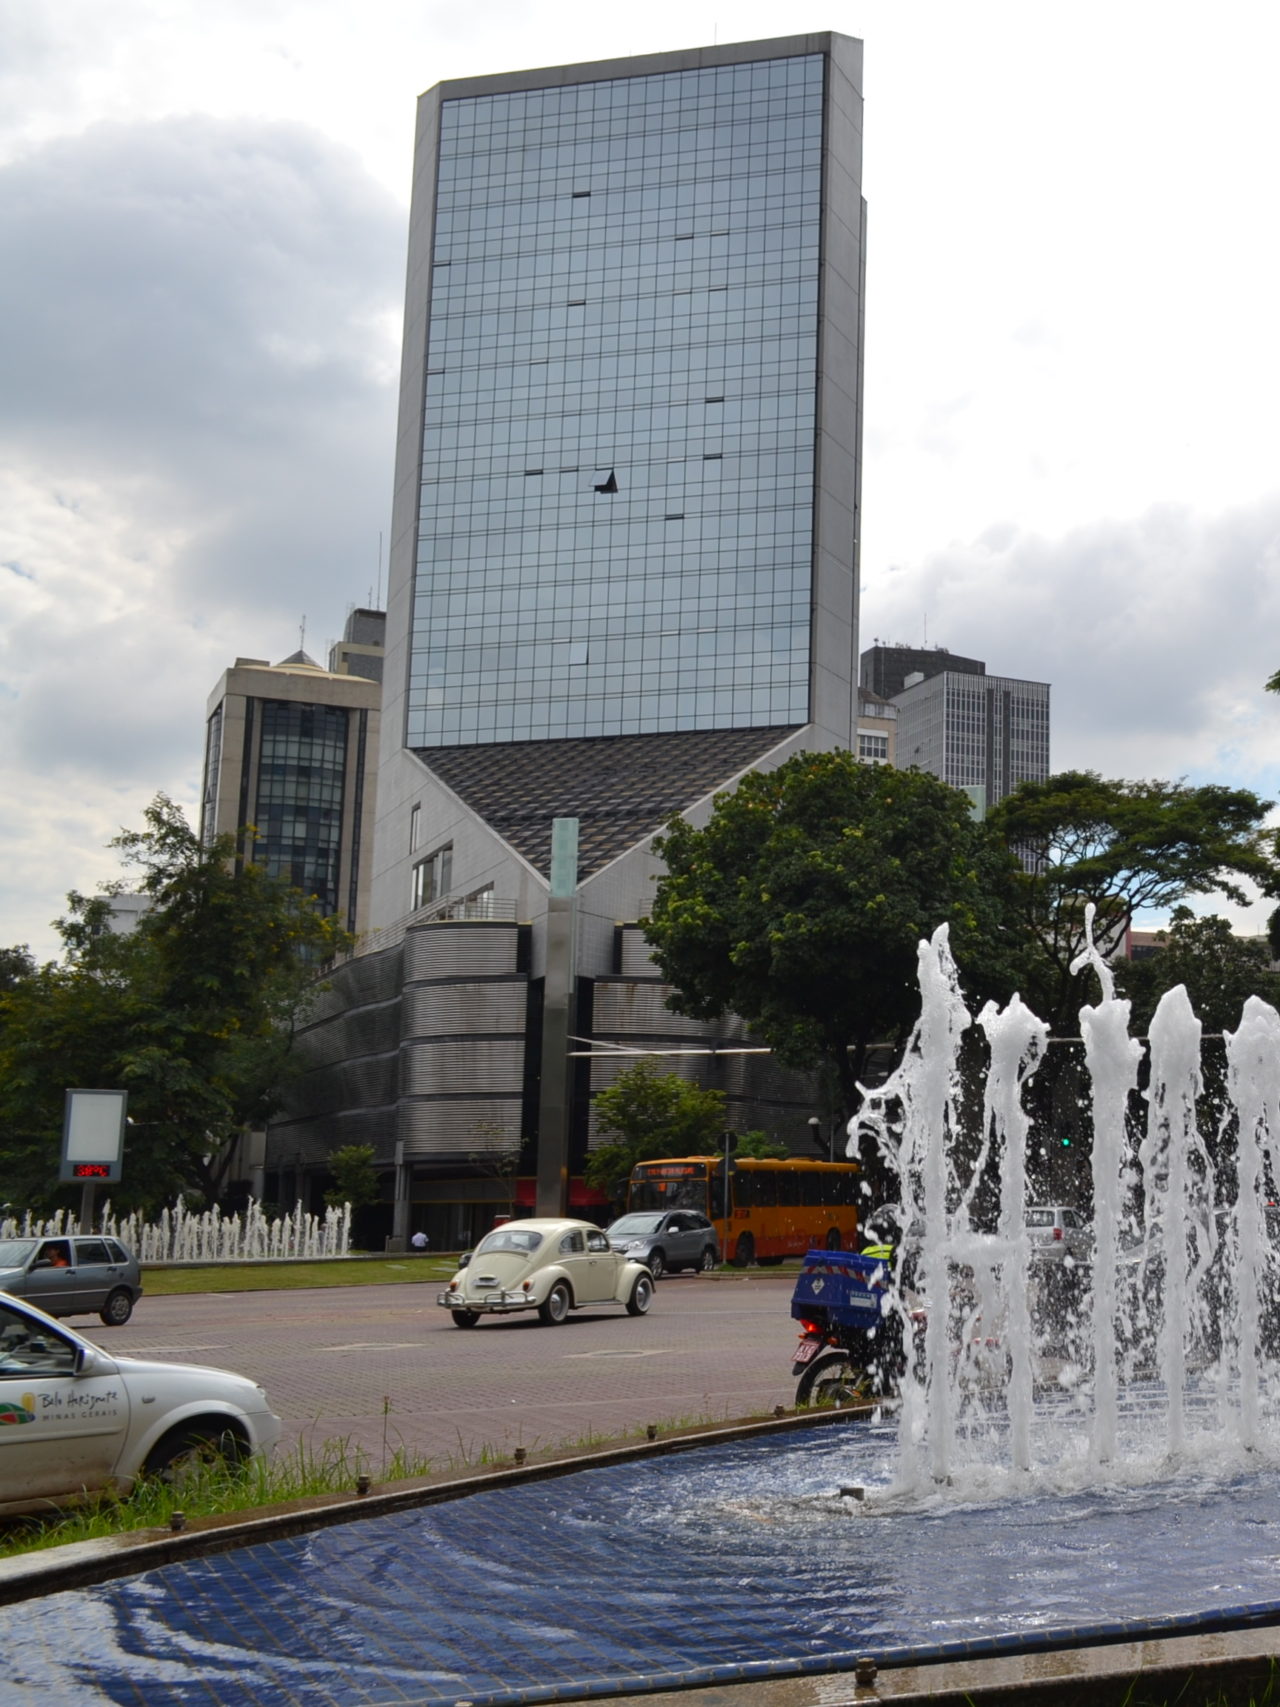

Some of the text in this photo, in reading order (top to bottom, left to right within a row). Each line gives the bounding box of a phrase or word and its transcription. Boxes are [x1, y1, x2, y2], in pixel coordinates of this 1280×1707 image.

[38, 1389, 118, 1410] Belo Horizonte
[42, 1409, 118, 1421] MINAS GERAIS
